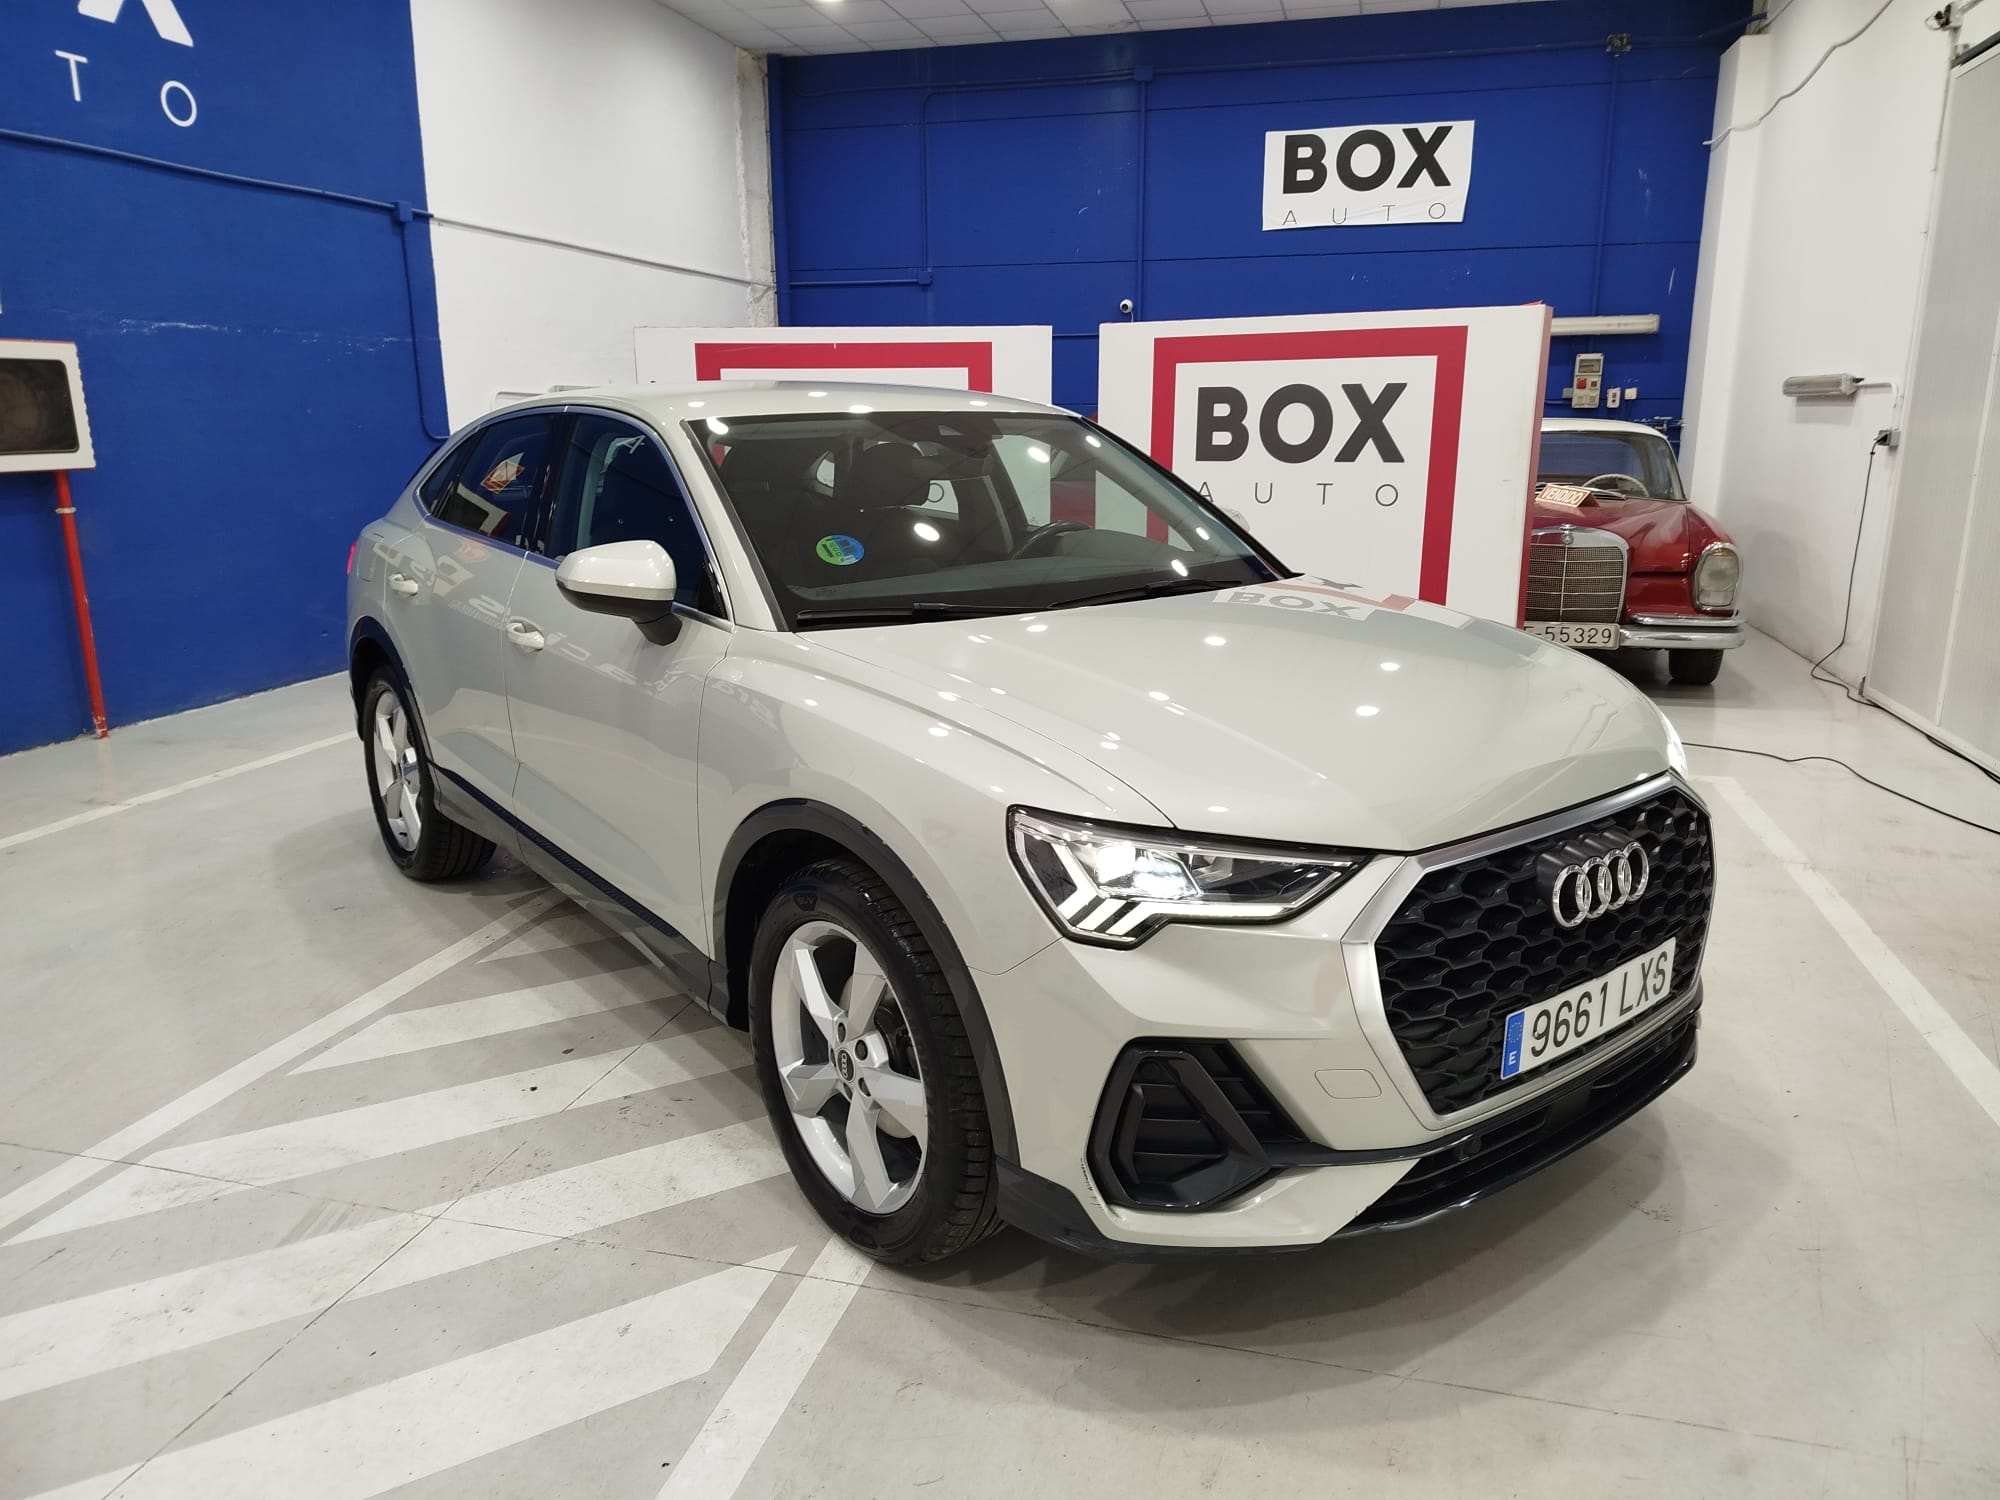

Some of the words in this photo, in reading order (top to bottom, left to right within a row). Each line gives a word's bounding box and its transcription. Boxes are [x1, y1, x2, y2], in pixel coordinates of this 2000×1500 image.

[1282, 125, 1454, 194] BOX
[1281, 202, 1447, 226] AUTO
[1195, 382, 1408, 464] BOX
[1198, 481, 1399, 507] AUTO
[1542, 486, 1584, 504] VENDIDO
[1530, 980, 1609, 1058] 9661
[1618, 950, 1668, 1018] LXS
[1508, 1050, 1517, 1066] E
